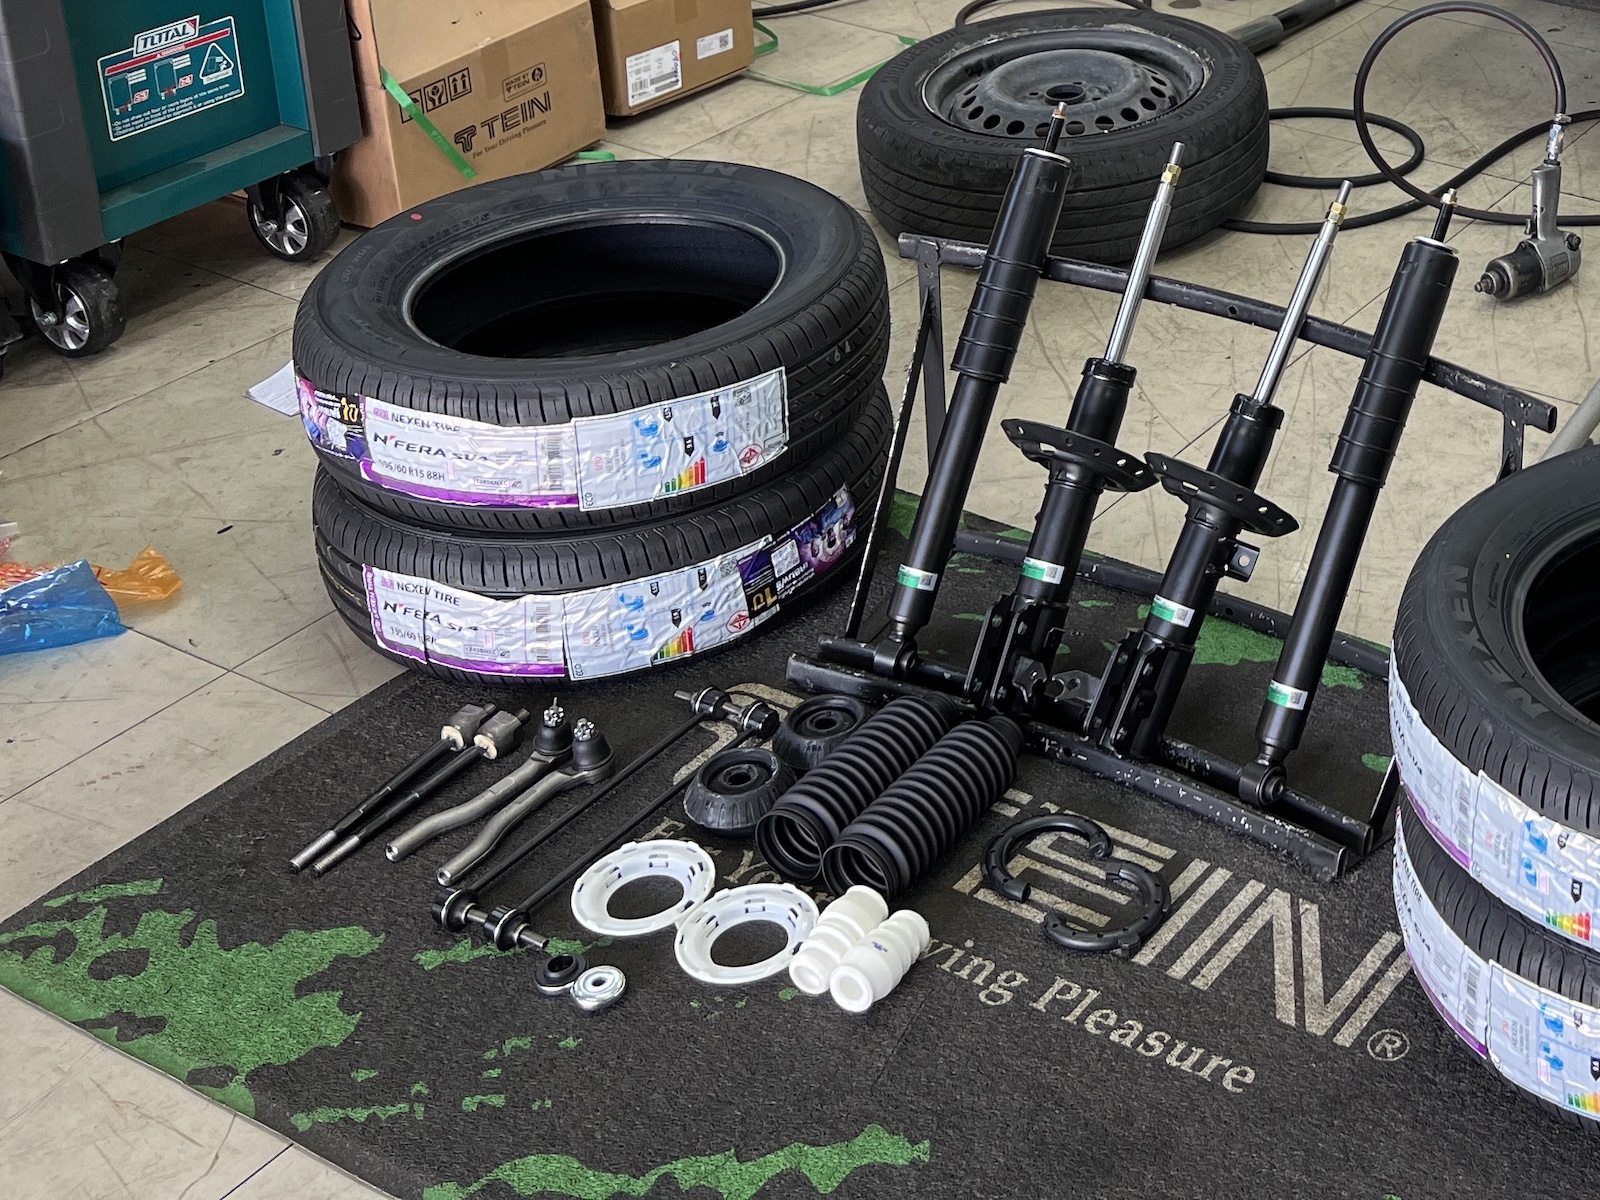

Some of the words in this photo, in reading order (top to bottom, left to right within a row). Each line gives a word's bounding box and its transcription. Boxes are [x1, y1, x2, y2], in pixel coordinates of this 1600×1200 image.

[140, 25, 190, 49] TOTAL
[505, 77, 519, 87] MADE
[512, 79, 530, 91] TEIN
[480, 91, 551, 139] TEIN
[473, 150, 483, 159] For
[484, 141, 498, 153] Your
[499, 131, 522, 146] Driving
[523, 119, 547, 135] Pleasure
[540, 161, 739, 181] NEXEN
[391, 412, 431, 429] NEXEN
[373, 431, 447, 458] N'FERA
[408, 466, 425, 479] R15
[427, 469, 445, 482] 88H
[433, 589, 461, 606] TIRE
[1030, 977, 1257, 1093] Pleasure
